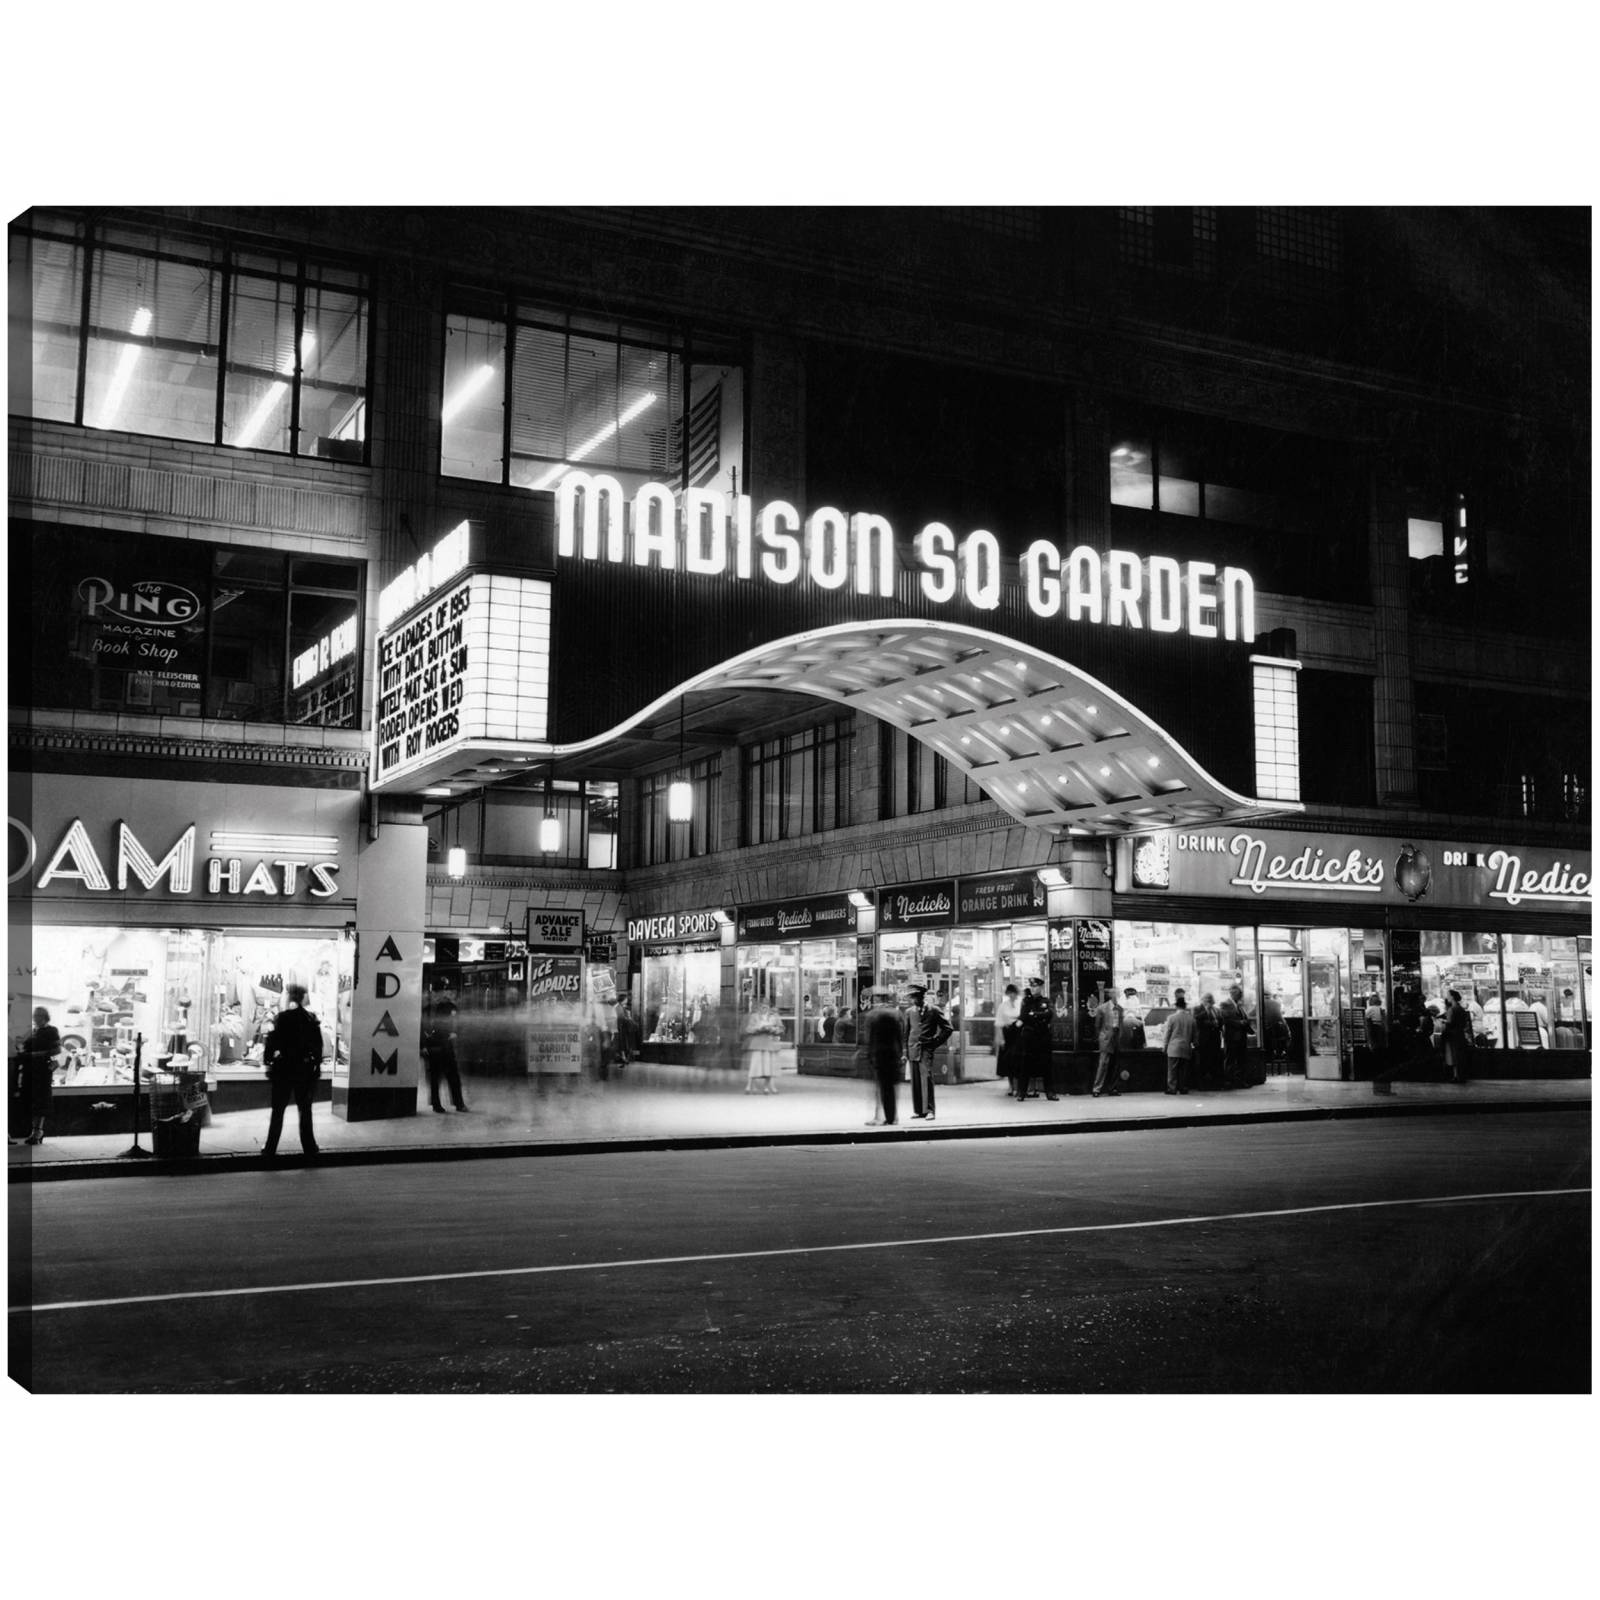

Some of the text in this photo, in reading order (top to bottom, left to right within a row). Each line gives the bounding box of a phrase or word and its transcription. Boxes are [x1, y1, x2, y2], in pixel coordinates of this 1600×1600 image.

[557, 471, 893, 597] MADISON
[920, 522, 1000, 610] SQ
[1027, 540, 1255, 643] GARDEN
[78, 577, 192, 617] RING
[103, 624, 176, 638] MAGAZINE
[395, 612, 433, 659] CAPADES
[436, 601, 448, 631] OF
[450, 585, 470, 623] 1953
[91, 638, 178, 664] Book Shop
[383, 618, 463, 693] WITH DICK BUTTON
[158, 671, 199, 682] FLEISCHER
[423, 663, 439, 694] SAT
[440, 658, 447, 685] &
[450, 644, 468, 678] SUN
[380, 677, 463, 746] RODEO OPENS WED
[382, 708, 459, 771] WITH ROY ROGERS
[1177, 833, 1384, 893] DRINK Nedick's
[1443, 850, 1487, 868] DRIK
[208, 858, 340, 896] HATS
[975, 883, 1014, 895] FRESH FRUIT
[896, 892, 951, 923] Nedick's
[962, 893, 1029, 913] ORANGE DRINK
[535, 914, 579, 927] ADVANCE
[541, 926, 572, 937] SALE
[628, 915, 675, 941] DAVEGA
[679, 912, 717, 934] SPORTS
[777, 907, 813, 933] Nedick's
[815, 908, 847, 921] HAMBURGERS
[1079, 950, 1110, 960] ORANGE
[532, 958, 554, 981] ICE
[531, 974, 580, 997] CAPADES
[370, 934, 403, 1076] ADAM
